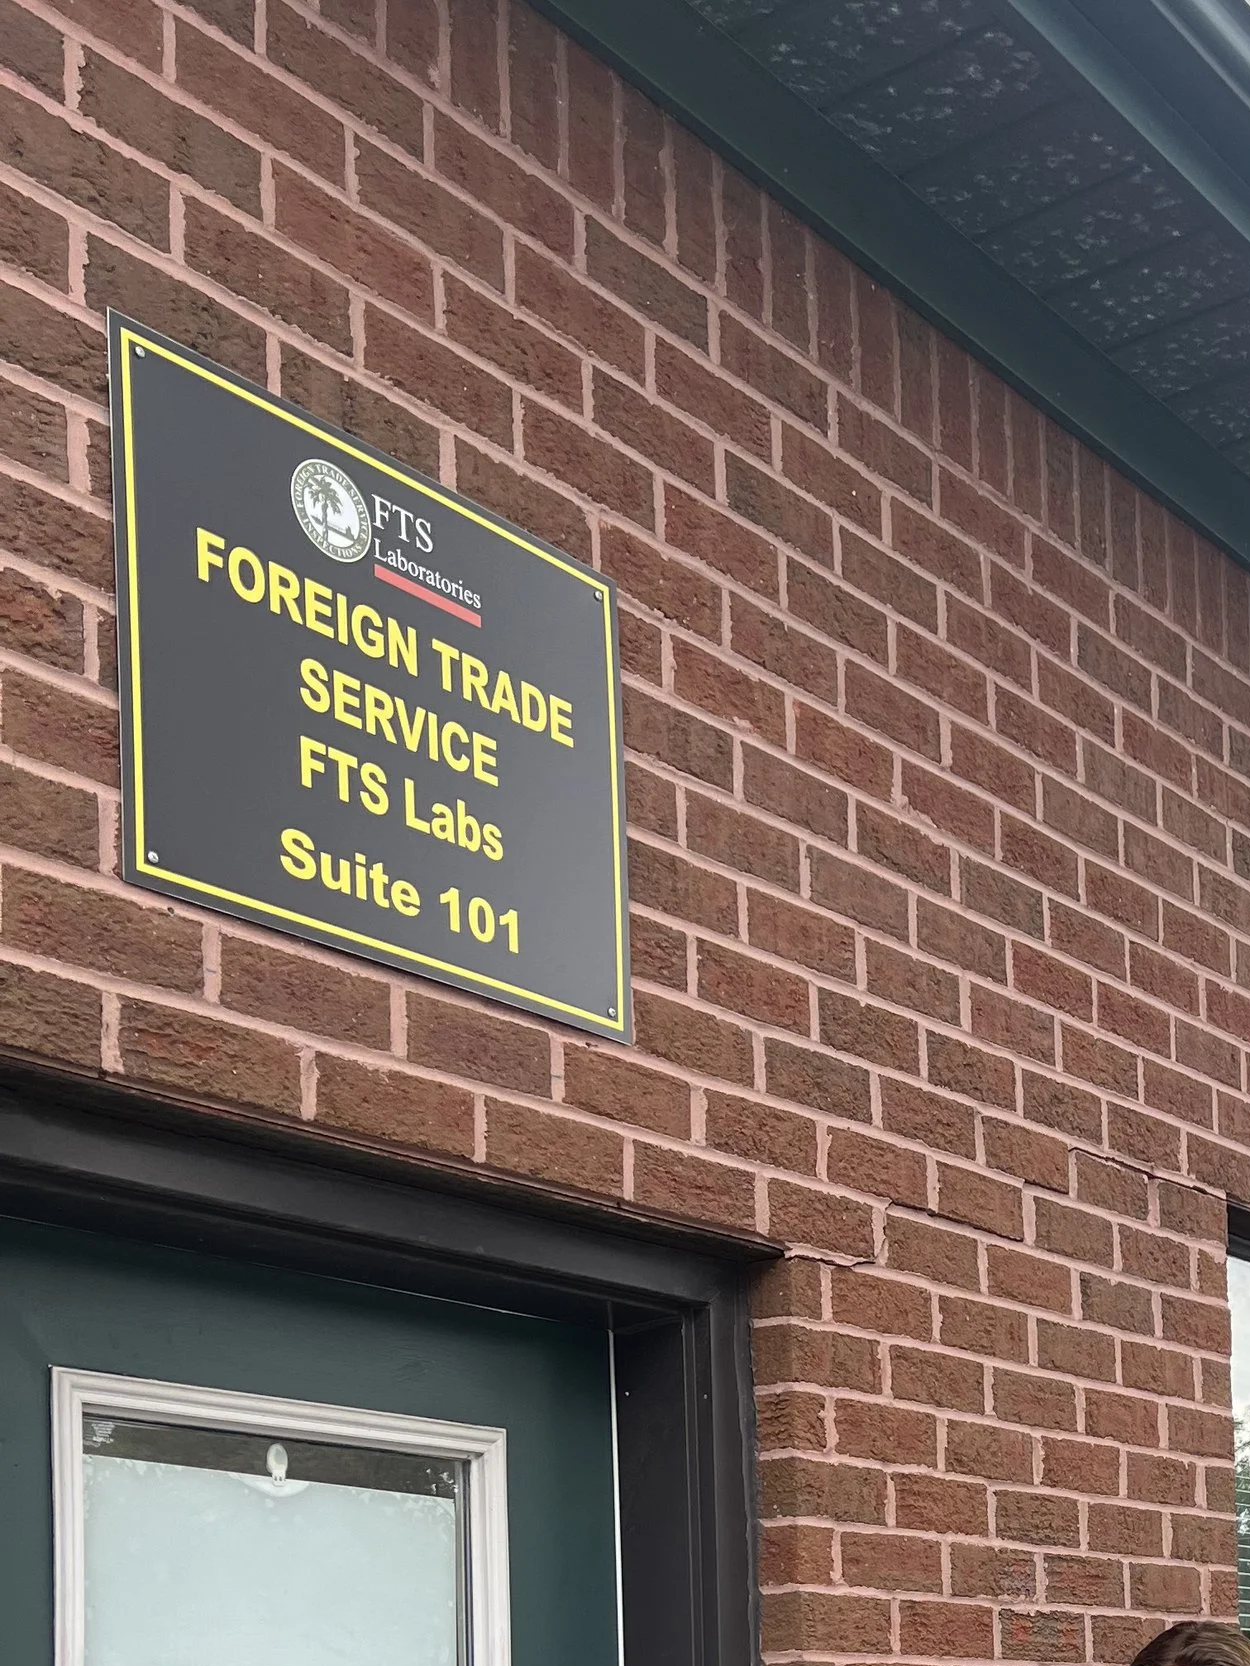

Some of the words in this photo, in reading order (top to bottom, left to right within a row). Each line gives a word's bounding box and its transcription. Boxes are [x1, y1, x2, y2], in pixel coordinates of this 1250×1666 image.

[303, 519, 362, 559] INSPECTIONS
[371, 494, 433, 553] FTS
[373, 538, 481, 609] Laboratories
[196, 527, 418, 677] FOREIGN
[432, 638, 574, 748] TRADE
[300, 658, 499, 787] SERVICE
[300, 736, 388, 816] FTS
[406, 779, 504, 861] Labs
[281, 828, 421, 917] Suite
[440, 886, 520, 953] 101
